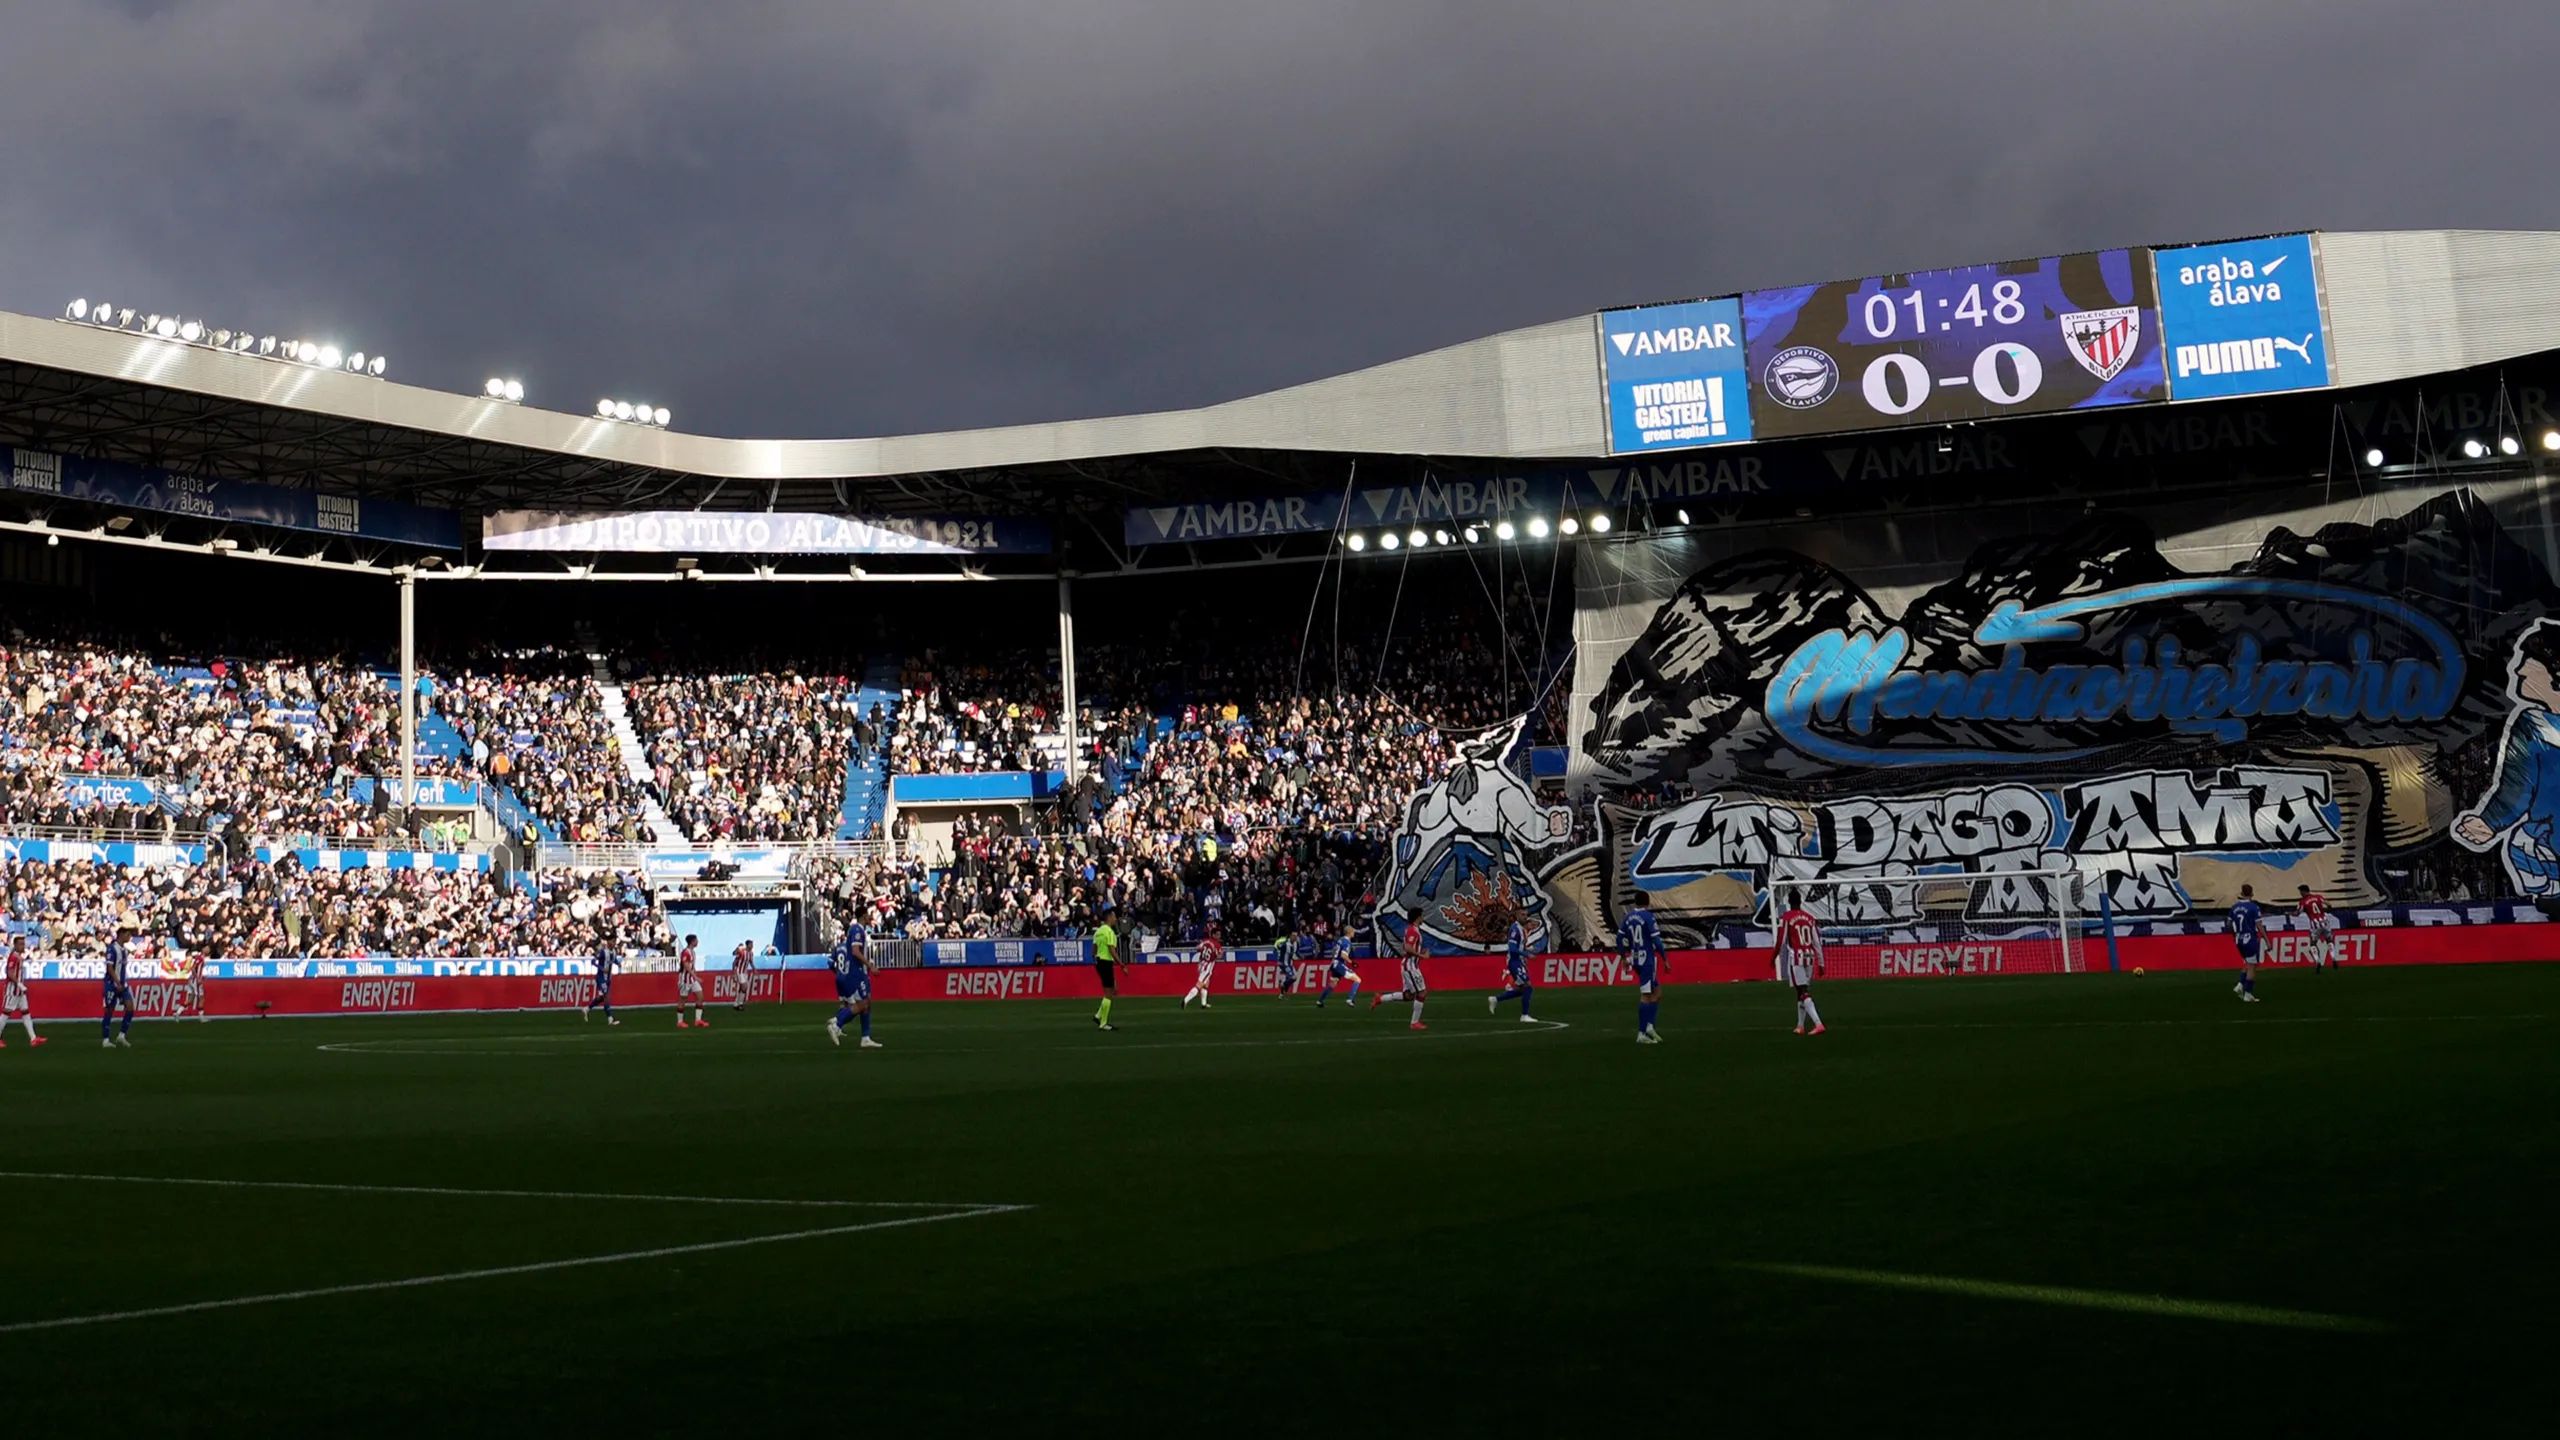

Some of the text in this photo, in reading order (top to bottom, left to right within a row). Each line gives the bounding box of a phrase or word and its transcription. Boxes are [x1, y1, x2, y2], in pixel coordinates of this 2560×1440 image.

[2180, 257, 2255, 285] araba
[2210, 282, 2281, 306] álava
[1865, 280, 2025, 338] 01:48
[2065, 308, 2135, 320] ATHLETIC CLUB
[1634, 323, 1736, 356] AMBAR
[1774, 349, 1826, 366] DEPORTIVO
[2088, 357, 2124, 379] BILBAO
[2176, 338, 2275, 377] PUMA
[1632, 379, 1706, 407] VITORIA
[1635, 401, 1708, 429] GASTEIZ
[1643, 423, 1709, 443] green capital
[2111, 410, 2278, 460] AMBAR
[14, 448, 54, 472] VITORIA
[1860, 434, 2016, 482] AMBAR
[14, 467, 54, 491] GASTEIZ
[167, 474, 204, 493] araba
[1620, 455, 1771, 500] AMBAR
[180, 491, 214, 514] álava
[317, 494, 353, 515] VITORIA
[1392, 477, 1536, 518] AMBAR
[317, 510, 353, 532] GASTEIZ
[1178, 497, 1312, 538] AMBAR
[569, 518, 770, 549] DEPORTIVO
[925, 520, 999, 548] 1921
[79, 779, 132, 804] invitec
[2071, 767, 2341, 852] AMA
[1806, 784, 2060, 866] DAGO
[1628, 924, 1644, 946] 14
[1795, 925, 1811, 946] 10
[2237, 914, 2245, 931] 7
[234, 962, 263, 976] Silken
[276, 962, 300, 977] Silk
[318, 962, 347, 976] Silken
[356, 962, 384, 975] Silken
[395, 961, 423, 974] Silken
[837, 953, 845, 971] 8
[1880, 945, 2002, 976] ENERYETI
[342, 980, 415, 1011] ENERYETI
[540, 978, 597, 1006] ENERYET
[946, 970, 1044, 999] ENERYETI
